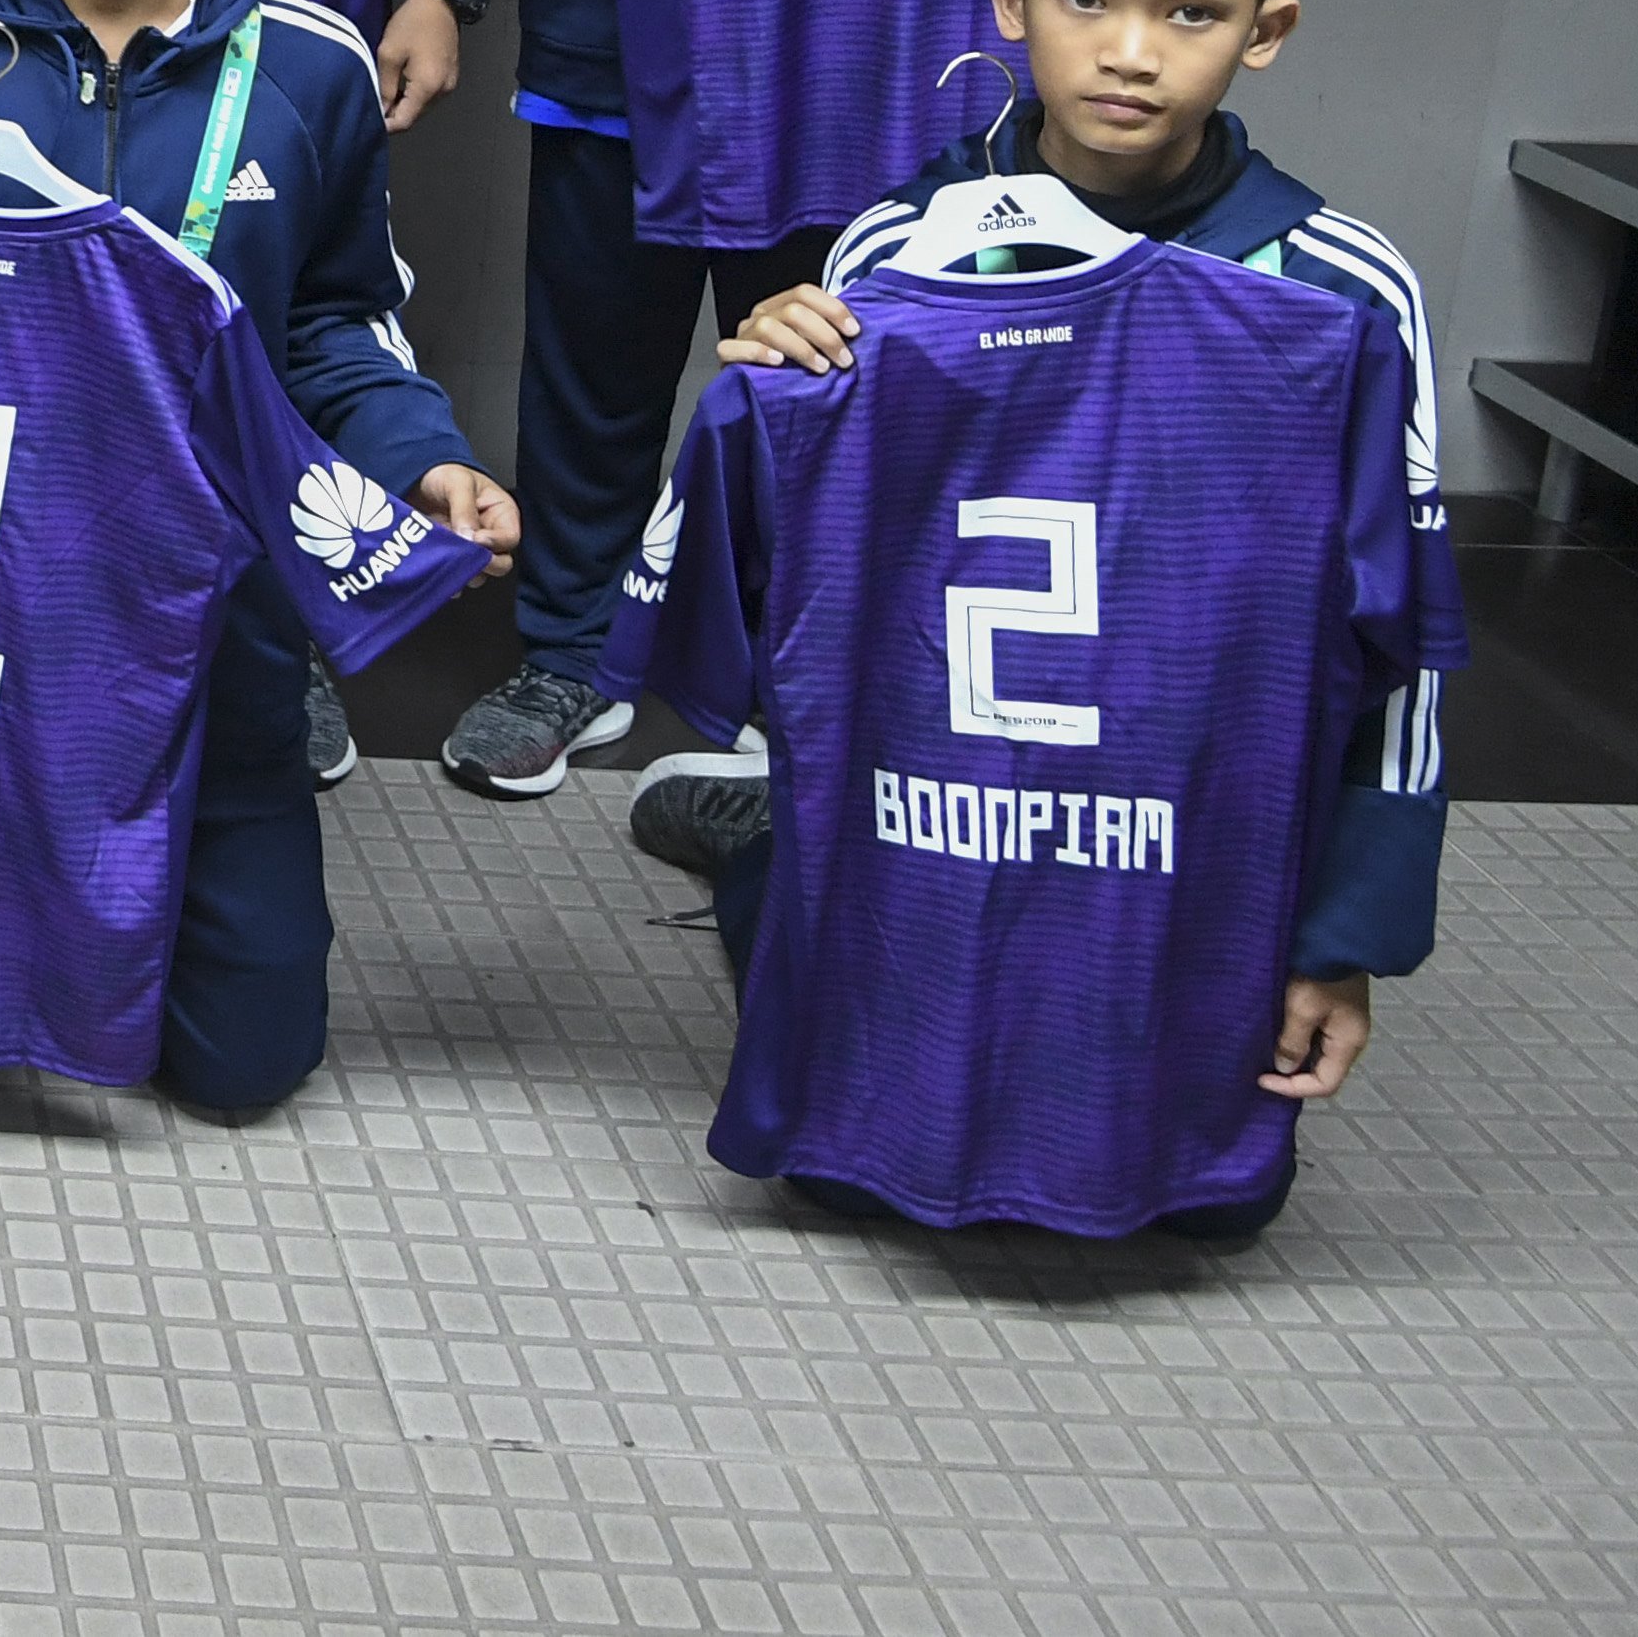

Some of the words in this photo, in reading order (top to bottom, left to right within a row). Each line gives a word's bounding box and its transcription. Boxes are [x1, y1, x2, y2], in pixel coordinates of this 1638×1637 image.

[977, 213, 1038, 233] adidas
[979, 332, 995, 349] EL
[1025, 325, 1074, 345] GRANDE
[328, 509, 434, 603] HUAWEI
[945, 496, 1100, 746] 2
[873, 766, 1175, 874] BOONPIAM
